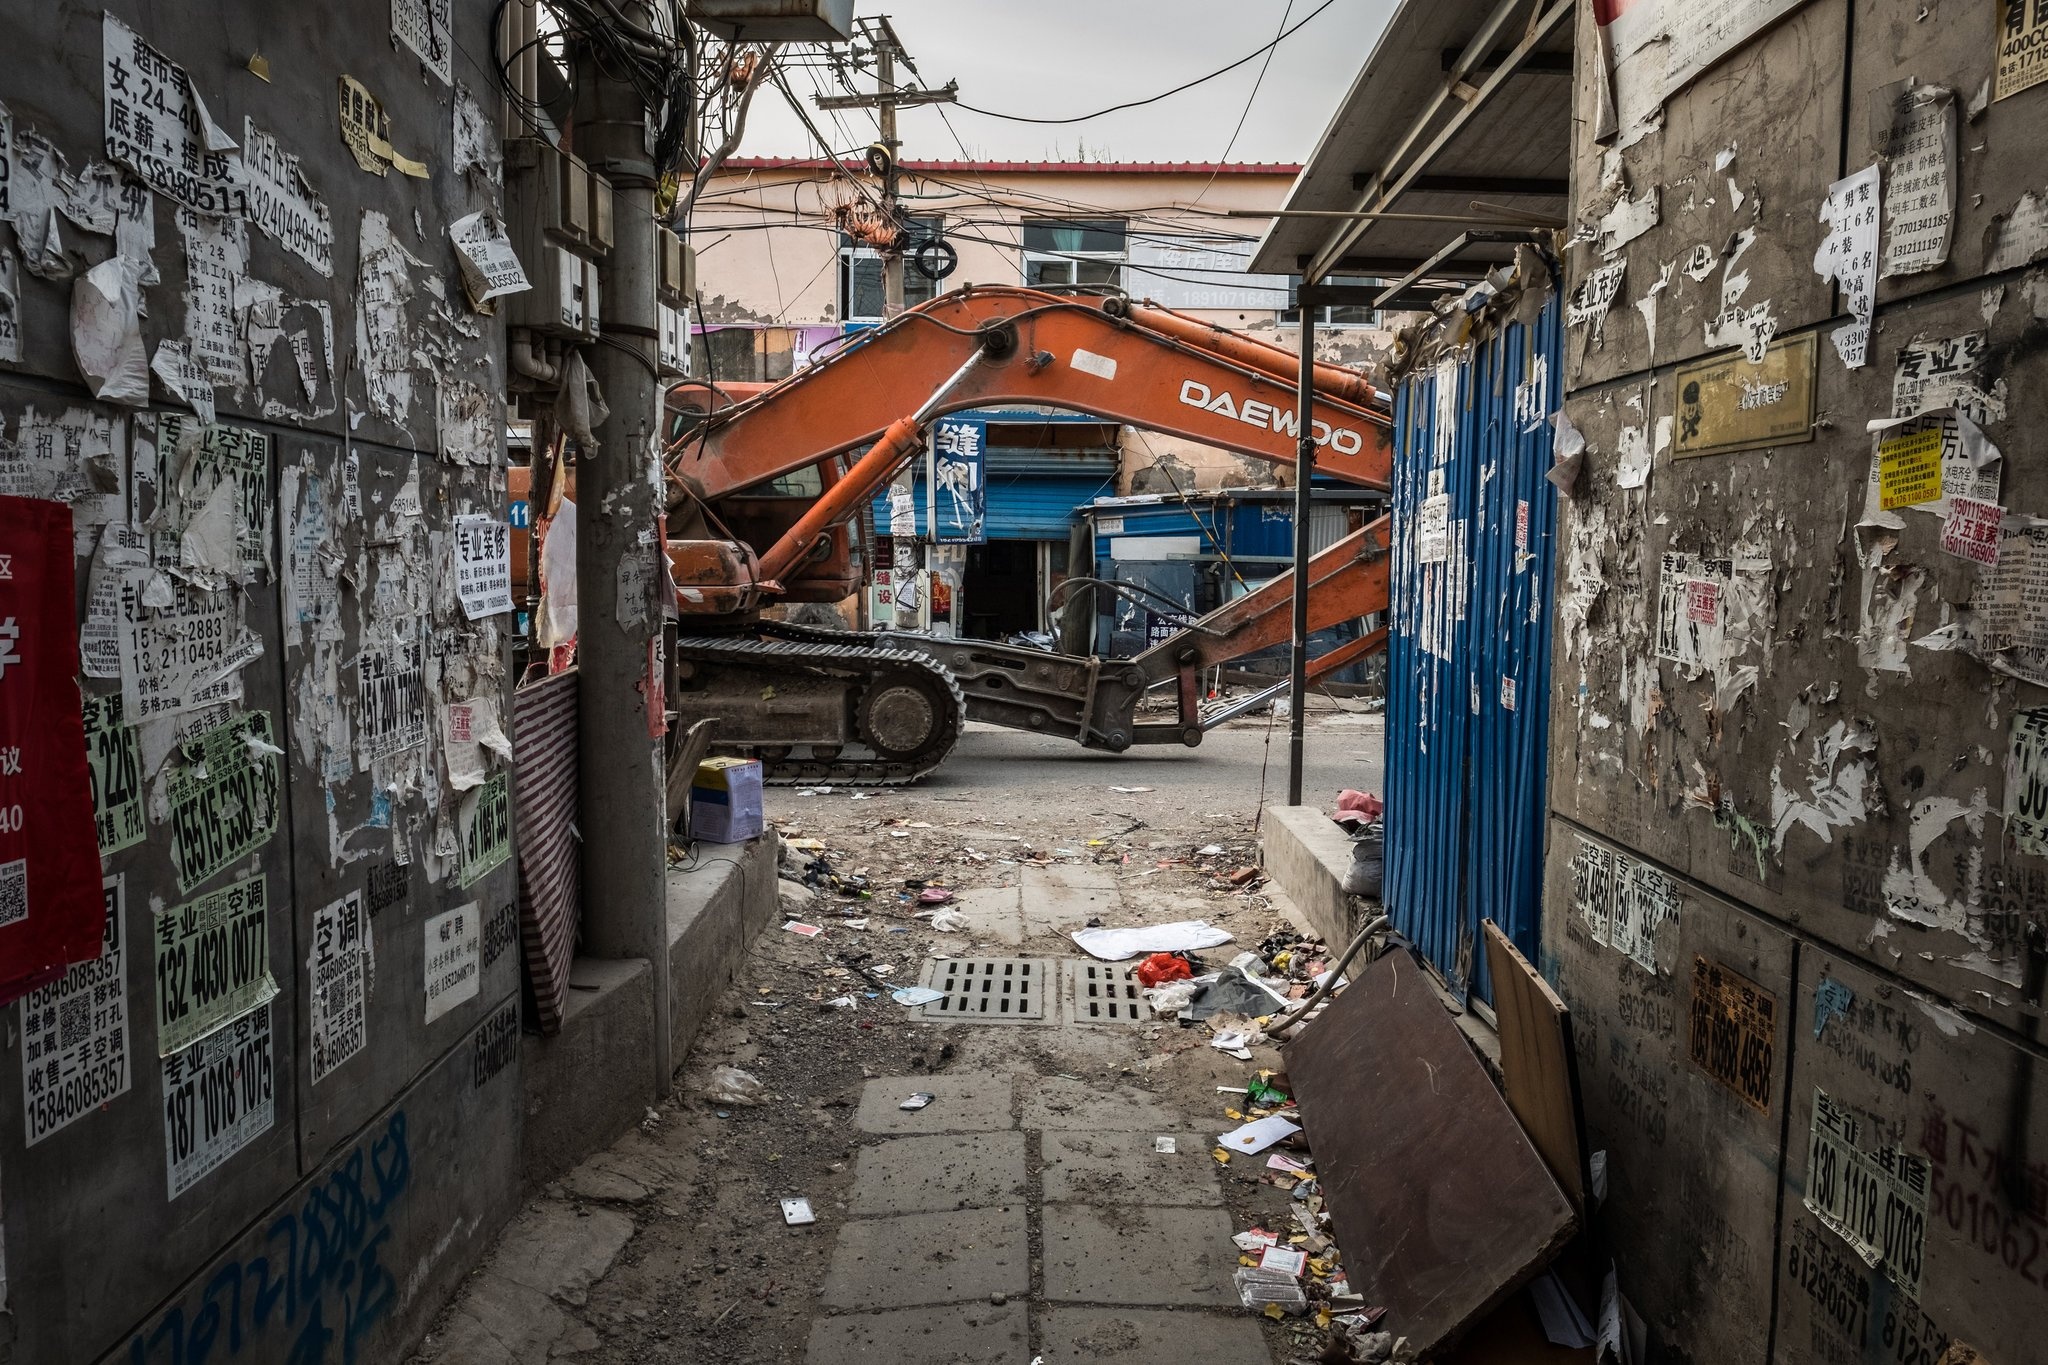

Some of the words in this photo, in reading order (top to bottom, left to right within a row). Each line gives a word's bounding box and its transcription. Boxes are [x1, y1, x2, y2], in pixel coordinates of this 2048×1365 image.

[134, 38, 186, 95] 超市导
[1179, 379, 1362, 456] DAEWOO
[1949, 515, 1998, 546] 小五搬家
[1954, 497, 2001, 526] 15011156909
[460, 525, 505, 563] 专业装修
[1945, 535, 1996, 564] 15011156909
[156, 900, 199, 946] 专业
[227, 886, 265, 920] 空调
[316, 897, 360, 967] 空调
[158, 942, 188, 1026] 132
[192, 926, 229, 1008] 4030
[231, 909, 267, 988] 0077
[25, 1006, 57, 1037] 维修
[93, 977, 122, 1006] 移机
[27, 1031, 57, 1063] 加氟
[94, 1009, 123, 1032] 打孔
[28, 1029, 125, 1096] 收售二手空调
[164, 1042, 205, 1086] 专业
[233, 1005, 270, 1048] 空调
[28, 1054, 125, 1140] 15846085357
[167, 1091, 195, 1166] 187
[201, 1056, 237, 1142] 1018
[239, 1032, 273, 1111] 1075
[1812, 1136, 1836, 1212] 130
[1843, 1159, 1878, 1246] 1118
[1884, 1190, 1923, 1284] 0703
